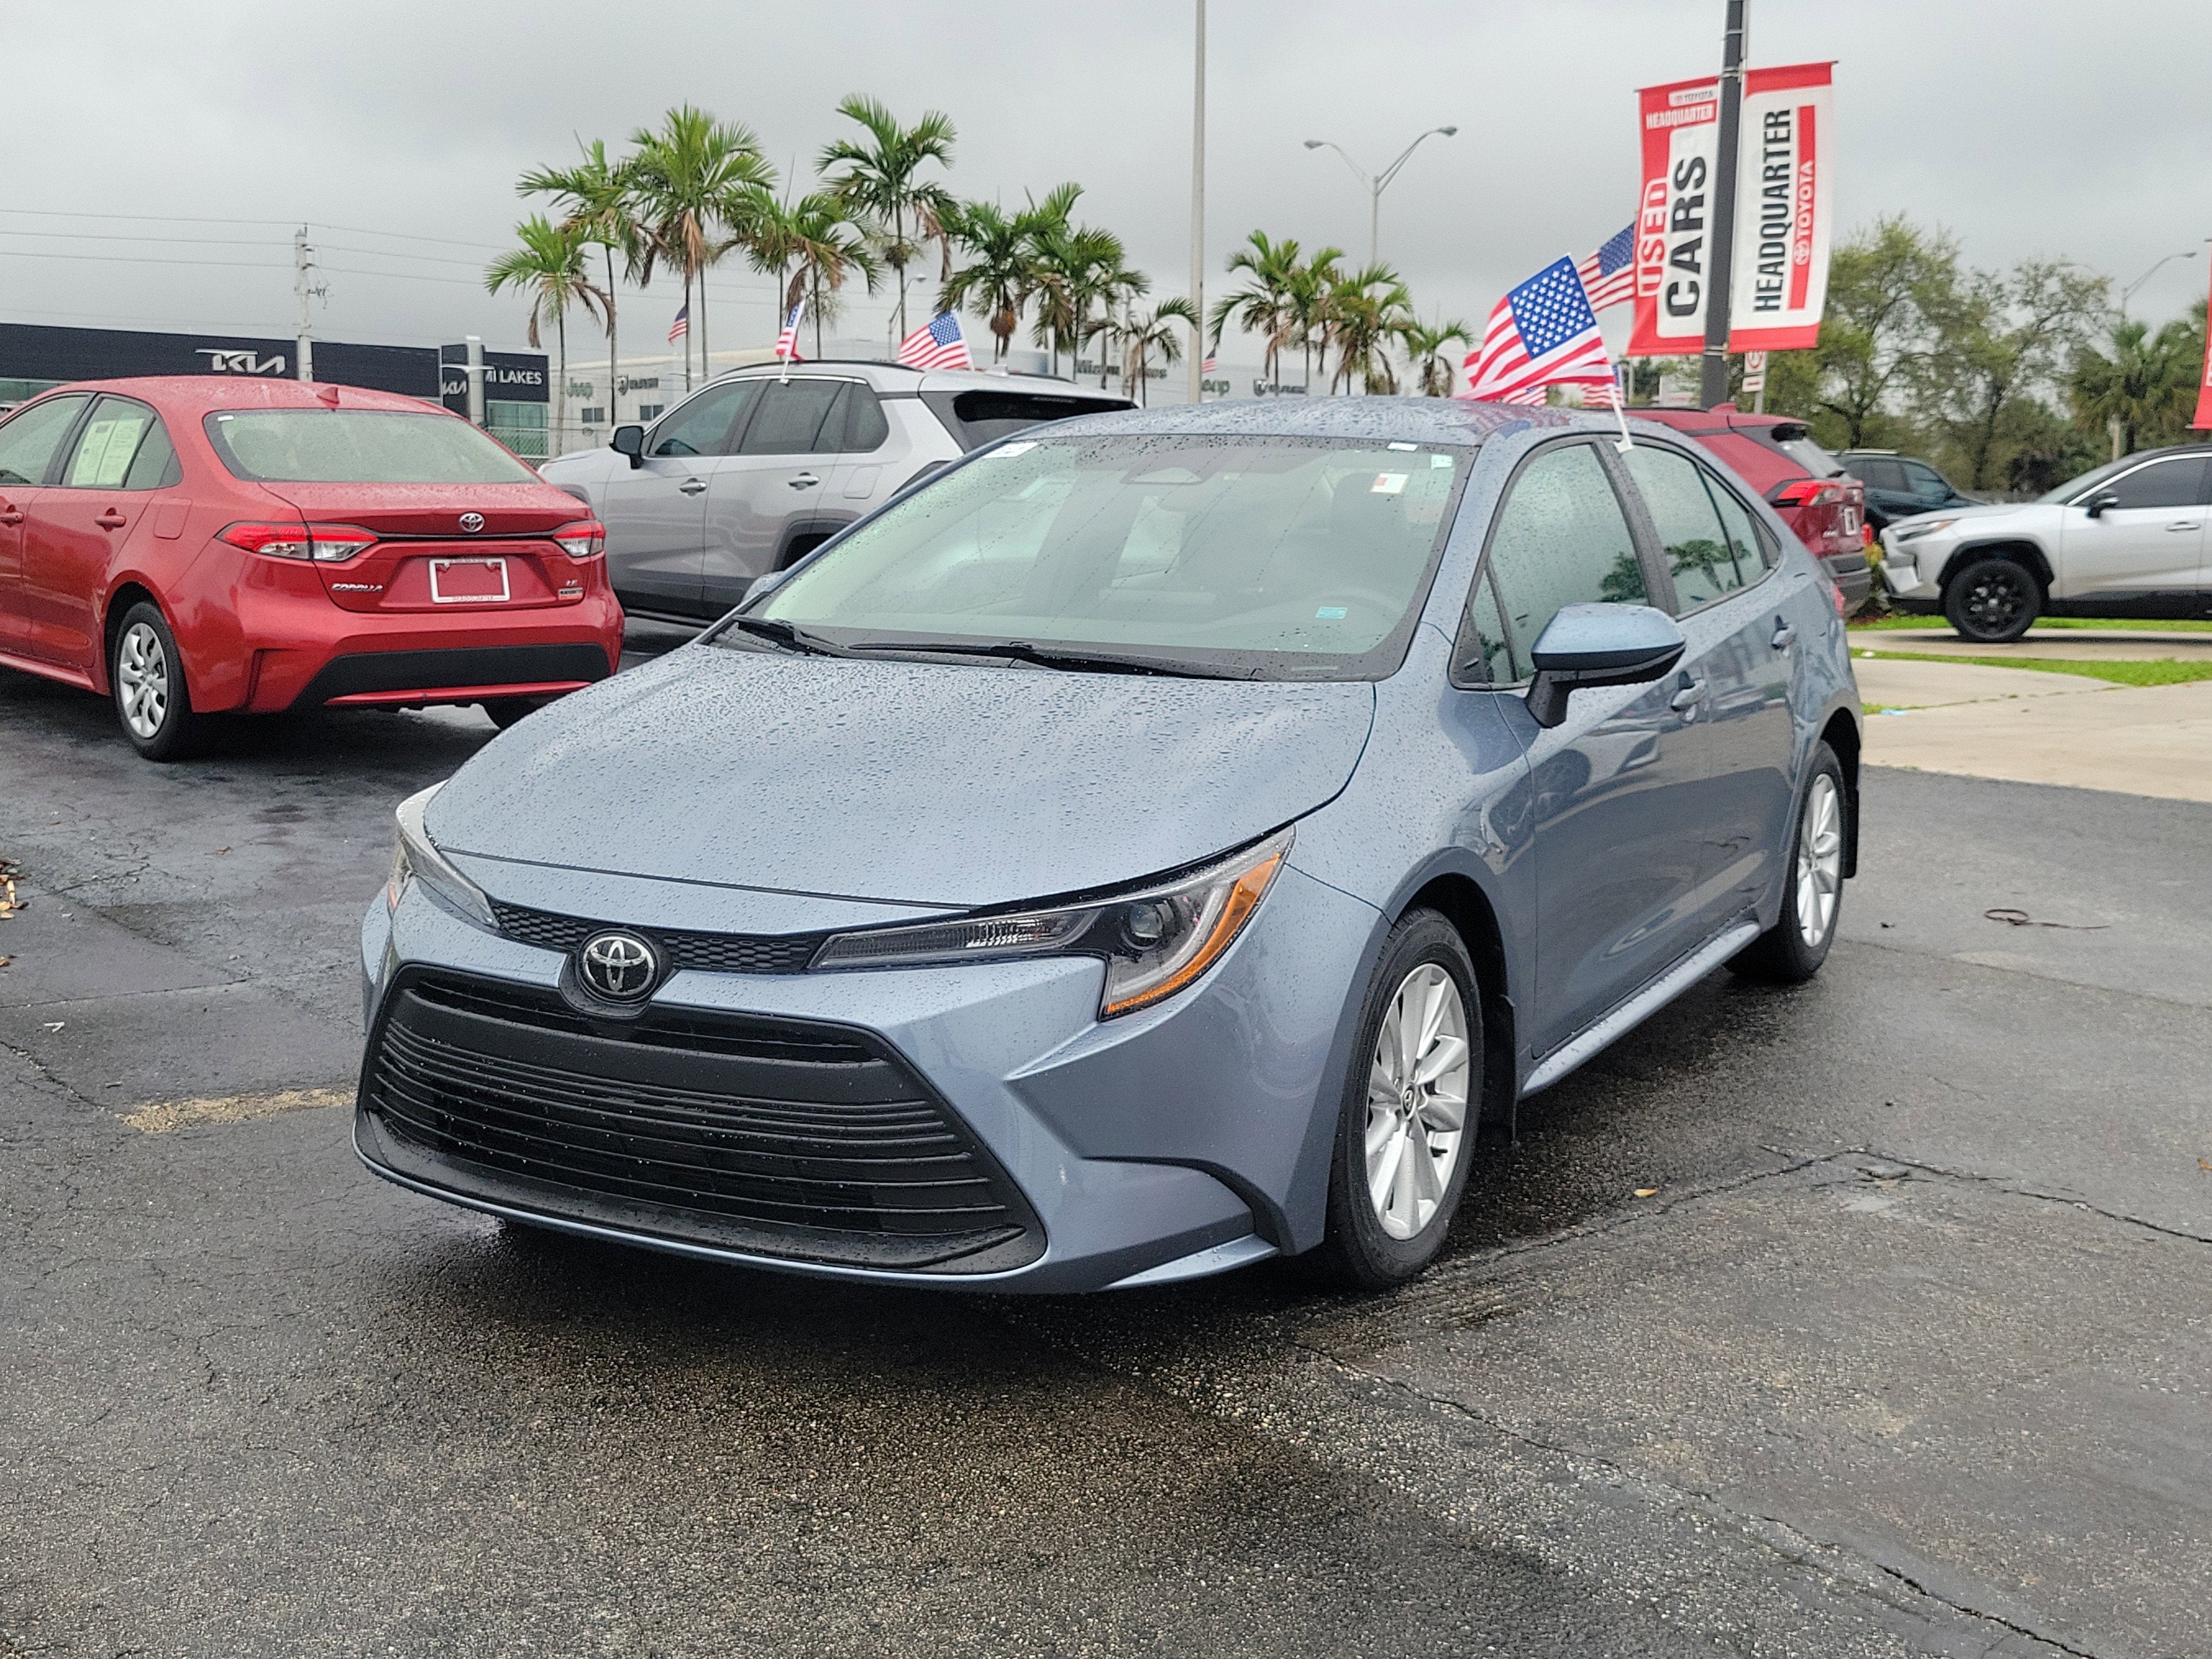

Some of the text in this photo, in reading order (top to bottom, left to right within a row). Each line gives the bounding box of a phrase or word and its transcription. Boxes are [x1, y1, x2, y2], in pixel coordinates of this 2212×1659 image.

[1646, 103, 1714, 130] HEADQUARTER
[1640, 180, 1668, 294] USED
[1666, 156, 1706, 318] CARS
[1753, 109, 1792, 312] HEADQUARTER
[1796, 159, 1814, 240] TOYOTA
[212, 353, 286, 375] KIA
[499, 369, 543, 385] LAKES
